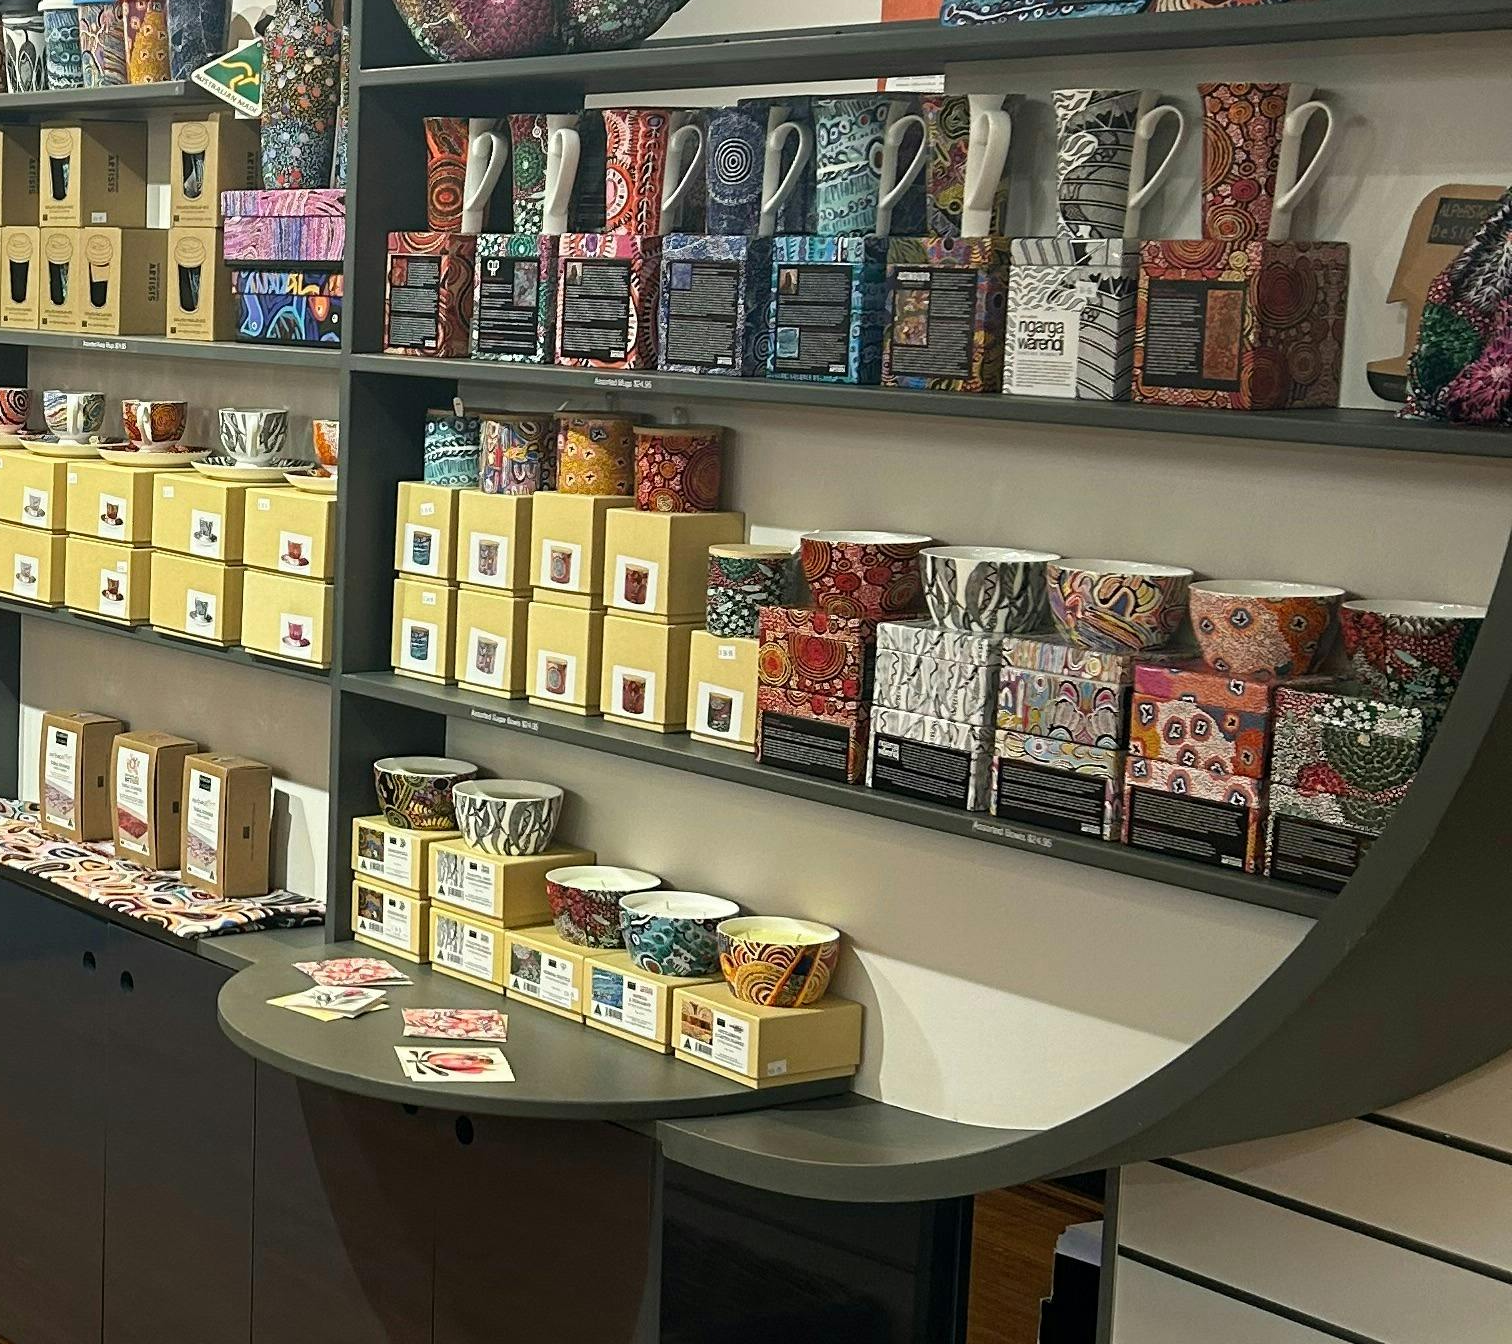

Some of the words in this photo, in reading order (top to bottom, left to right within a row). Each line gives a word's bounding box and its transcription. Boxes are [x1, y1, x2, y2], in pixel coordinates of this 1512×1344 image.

[194, 73, 238, 103] AUSTRALIAN
[237, 99, 259, 113] MADE
[1018, 320, 1064, 337] ngarga
